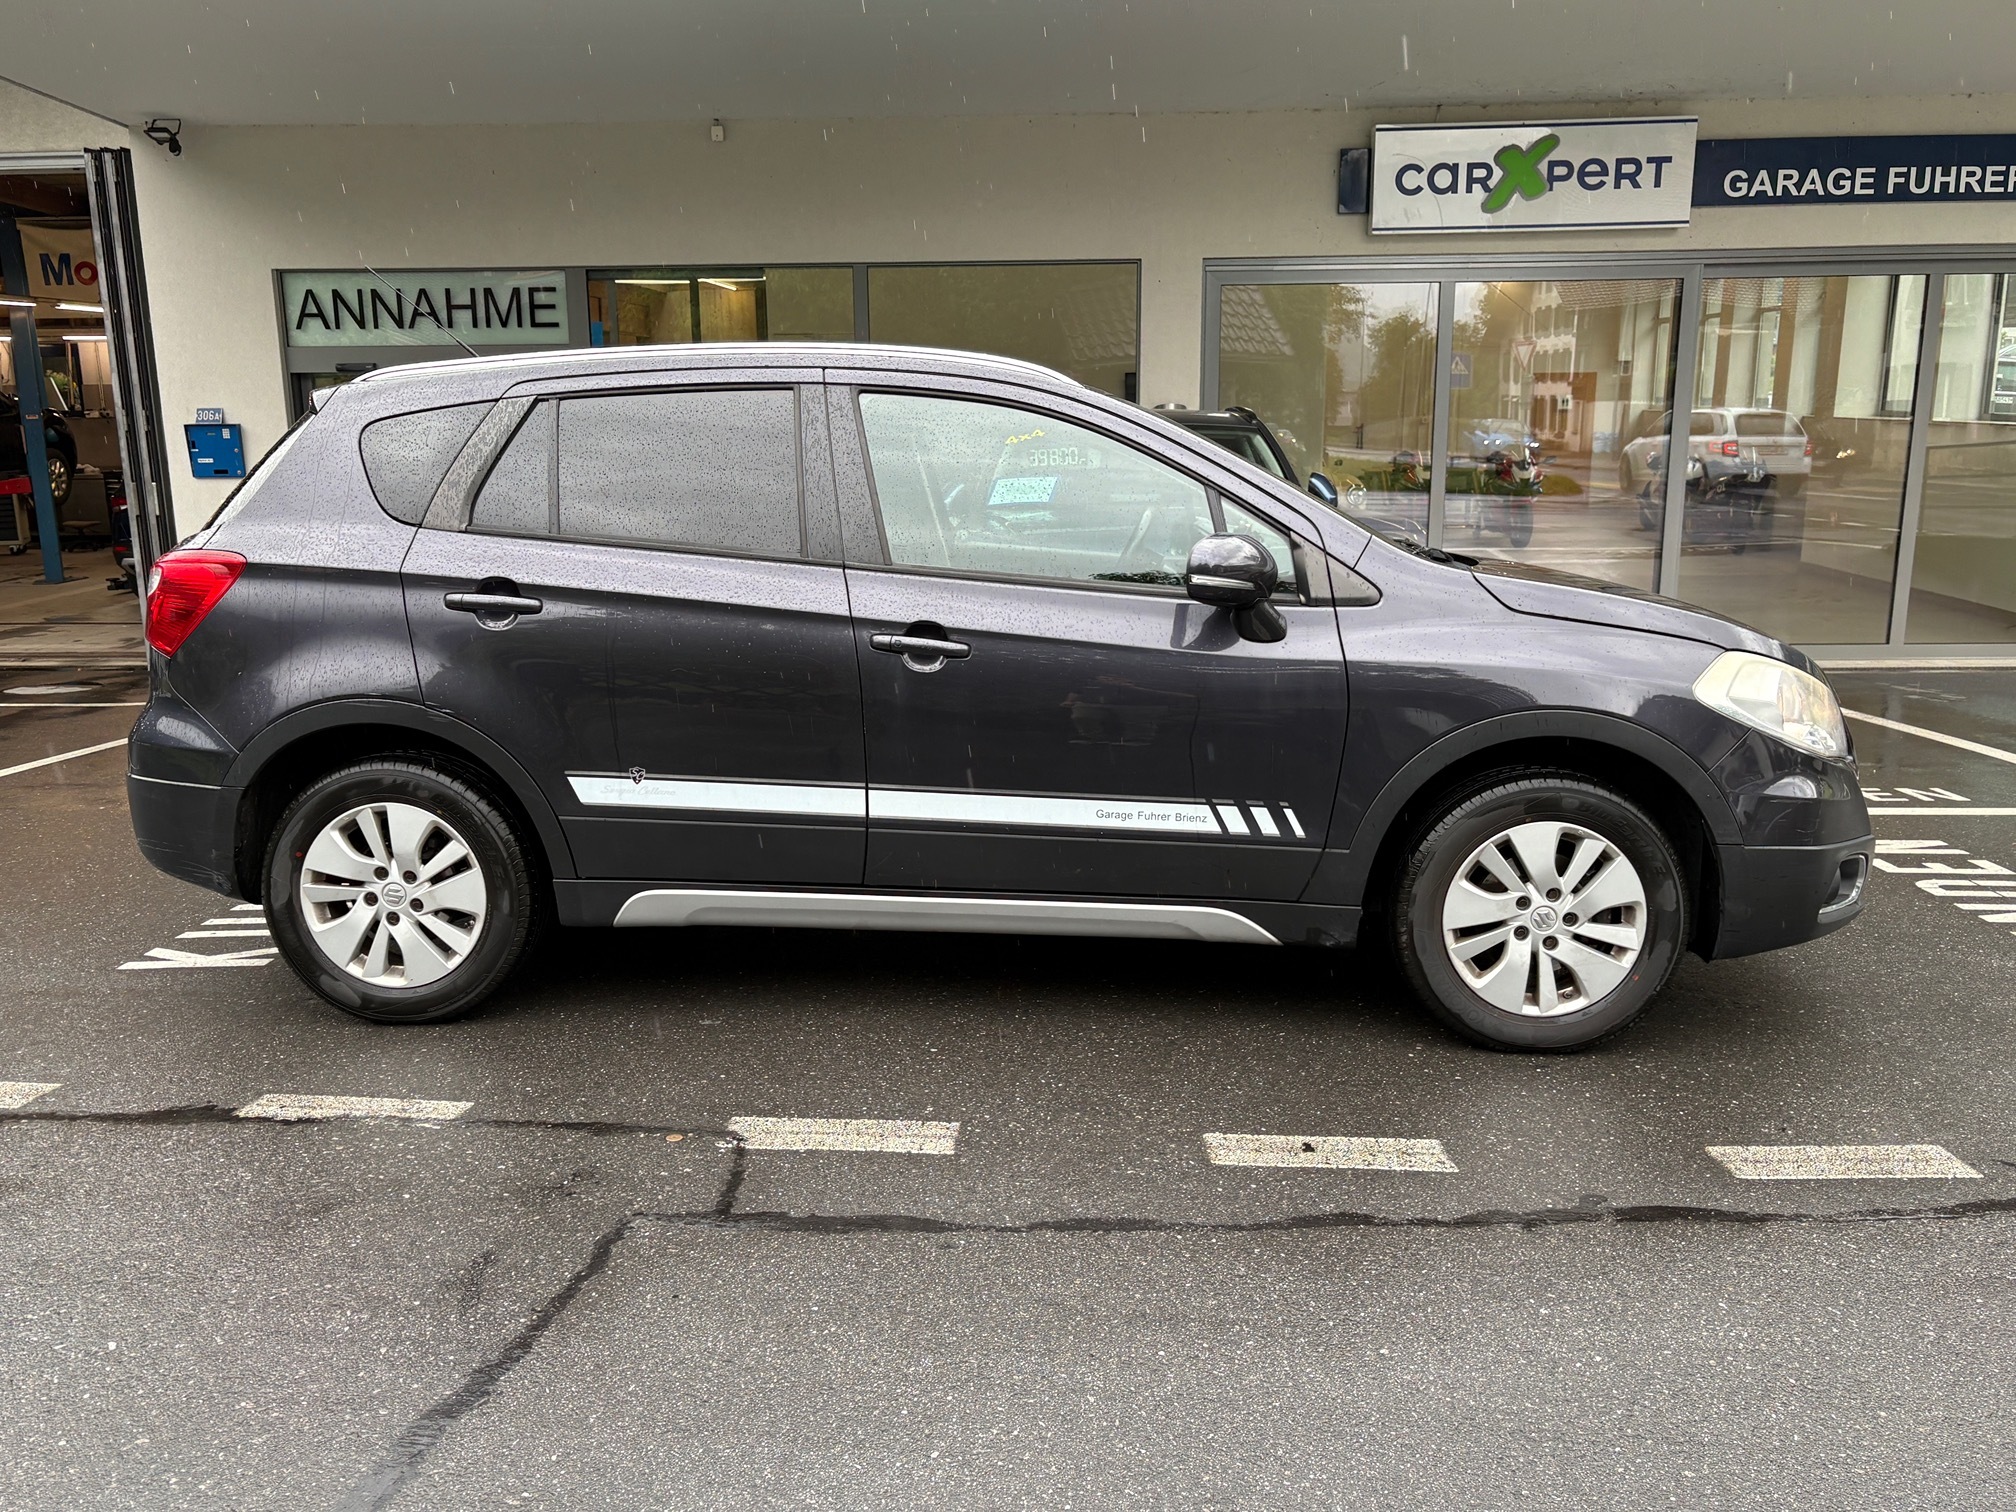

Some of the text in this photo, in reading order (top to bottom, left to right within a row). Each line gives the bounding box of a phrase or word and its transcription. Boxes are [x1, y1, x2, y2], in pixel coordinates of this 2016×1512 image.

[1723, 166, 1876, 198] GARAGE
[295, 286, 560, 332] ANNAHME
[197, 410, 220, 421] 306A
[1095, 809, 1208, 824] Garage Fuhrer Brienz
